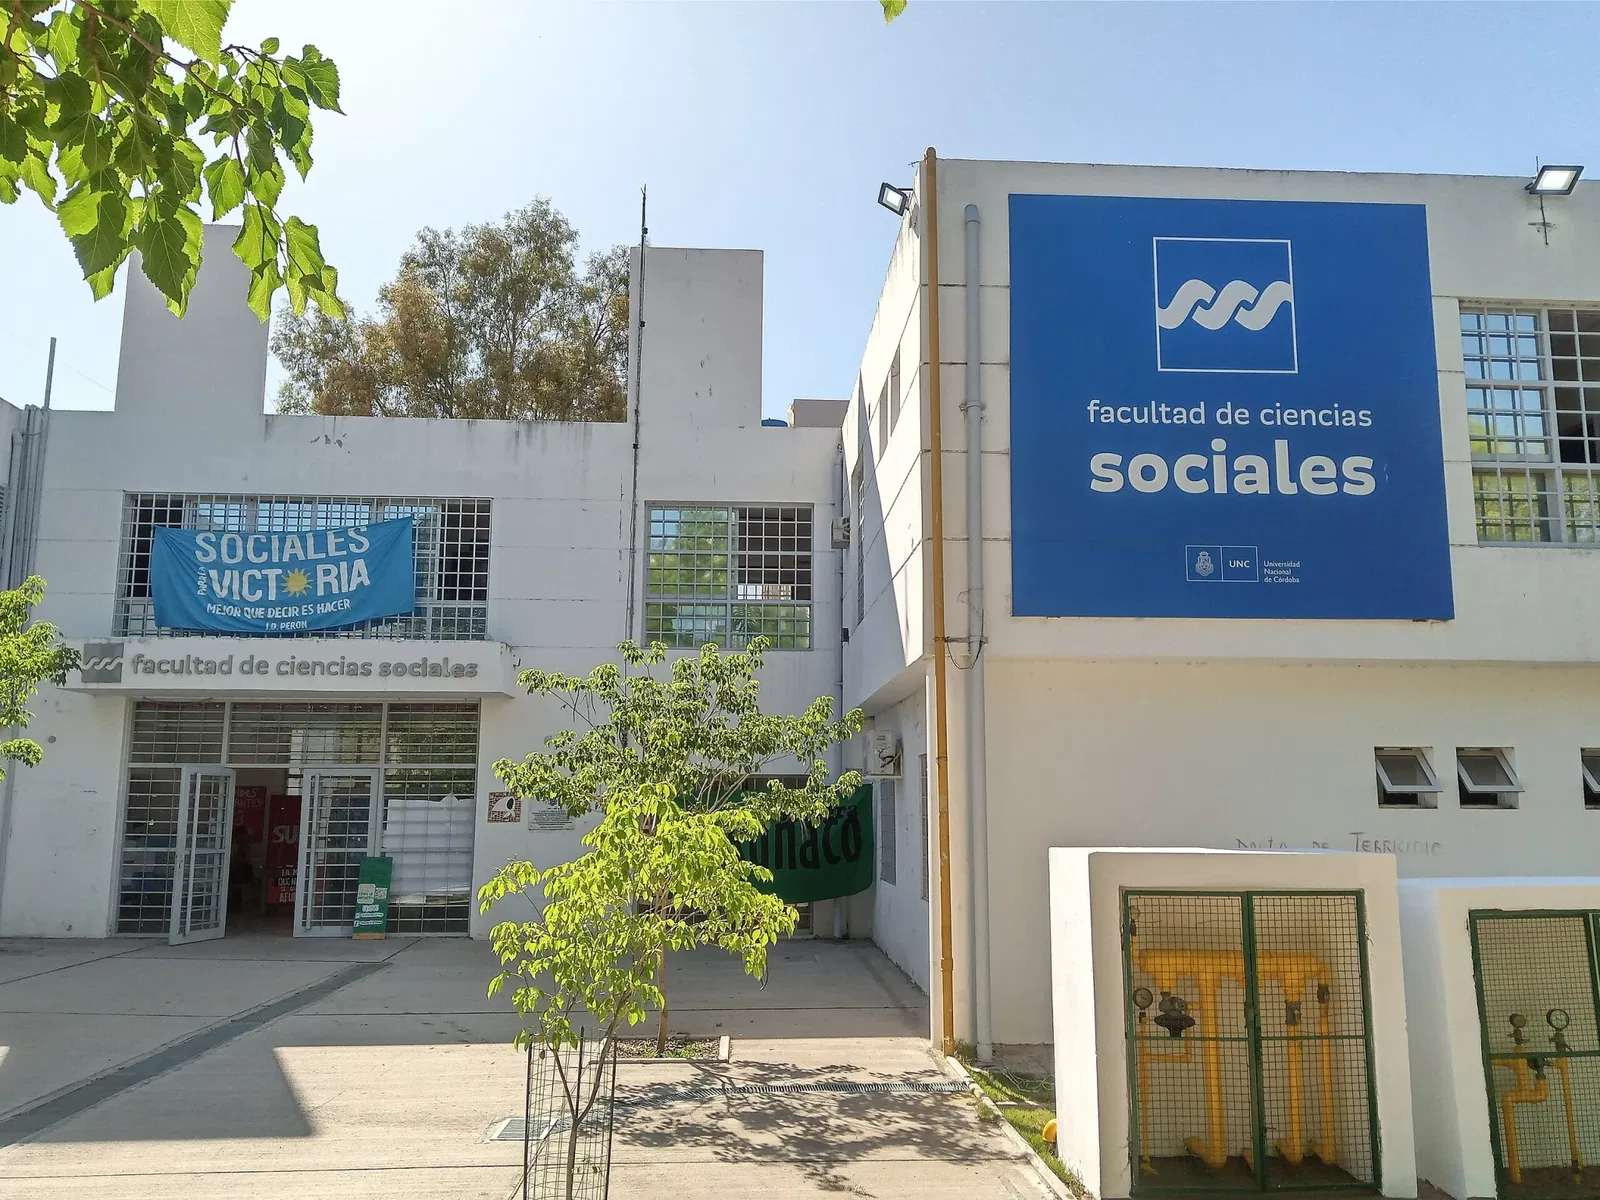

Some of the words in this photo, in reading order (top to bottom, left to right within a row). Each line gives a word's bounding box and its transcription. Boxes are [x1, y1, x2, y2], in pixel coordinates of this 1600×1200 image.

[1087, 399, 1206, 425] facultad
[1216, 402, 1250, 425] de
[1260, 402, 1373, 427] ciencias
[1090, 438, 1377, 495] sociales
[195, 526, 370, 564] SOCIALES
[1229, 560, 1250, 568] UNC
[1263, 560, 1301, 568] Universidad
[206, 602, 241, 618] MEJOR
[243, 607, 265, 619] QUE
[267, 605, 299, 619] DECIR
[301, 603, 314, 616] ES
[316, 598, 351, 615] HACER
[280, 620, 308, 631] PERON
[132, 653, 234, 675] facultad
[239, 654, 270, 675] de
[276, 655, 373, 677] ciencias
[378, 656, 479, 678] sociales
